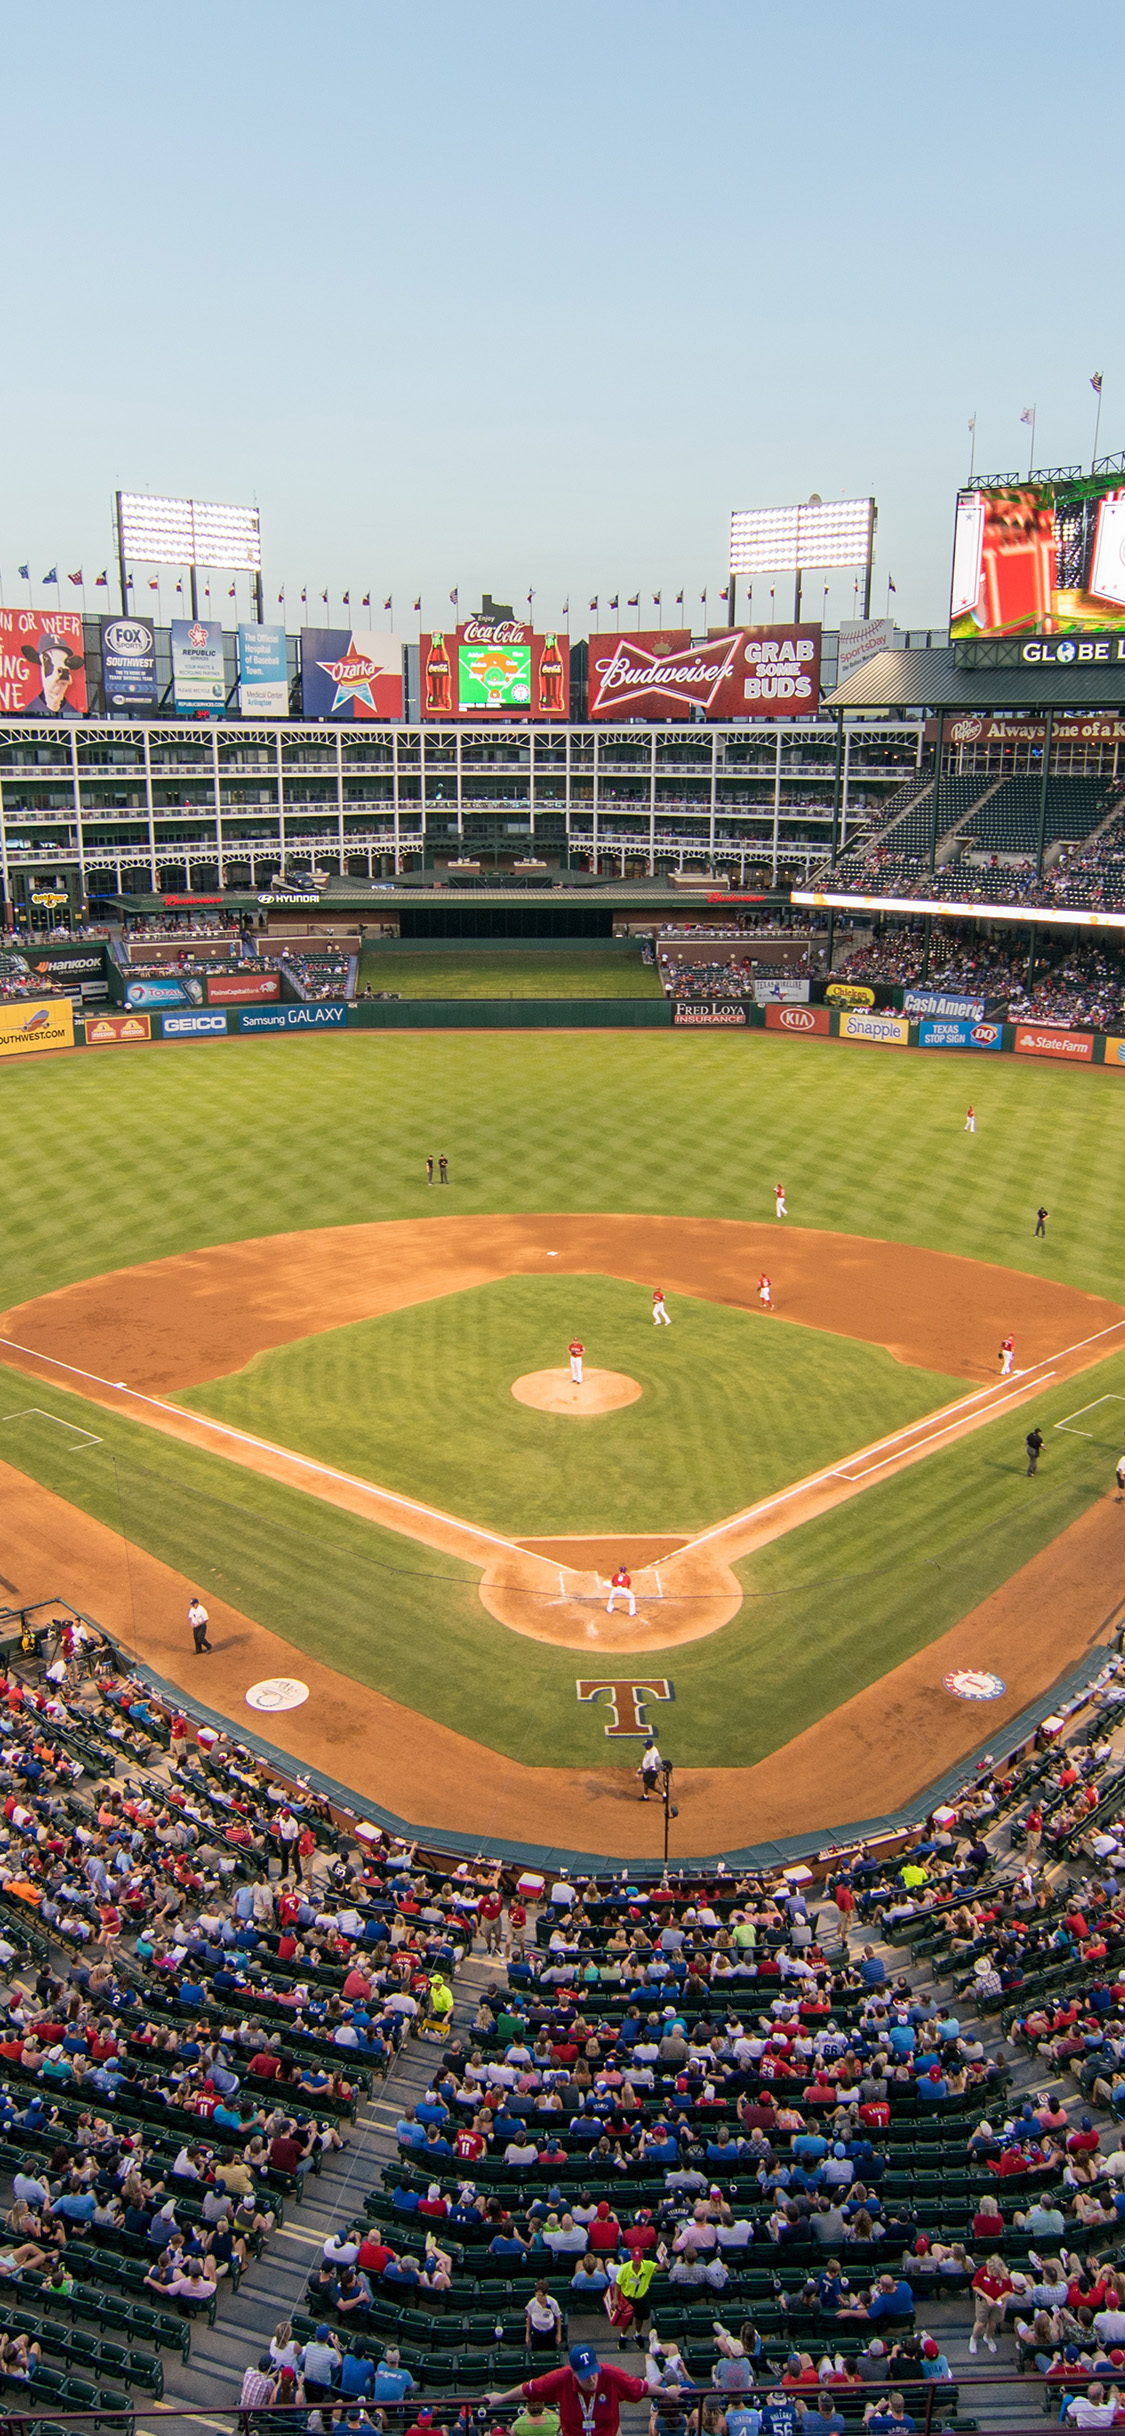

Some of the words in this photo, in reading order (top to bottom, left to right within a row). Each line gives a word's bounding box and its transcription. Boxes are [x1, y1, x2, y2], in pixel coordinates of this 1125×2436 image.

[19, 612, 38, 633] OR
[41, 615, 80, 637] WEER
[477, 615, 495, 623] Enjoy
[116, 629, 141, 643] FOX
[463, 620, 526, 643] Coca-Cola
[244, 633, 256, 643] The
[257, 633, 279, 644] Official
[182, 649, 217, 657] REPUBLIC
[245, 644, 271, 655] Hospital
[744, 640, 815, 664] GRAB
[840, 634, 887, 663] SportsDay
[106, 656, 154, 669] SOUTHWEST
[245, 655, 253, 664] of
[253, 655, 280, 665] Baseball
[331, 660, 375, 682] Ozarka
[595, 657, 734, 689] Budweiser
[755, 662, 801, 678] SOME
[744, 676, 812, 700] BUDS
[246, 691, 266, 699] Medical
[247, 700, 272, 708] Arlington
[962, 719, 973, 729] Dr
[952, 724, 980, 742] Pepper
[987, 722, 1046, 740] Always
[1081, 722, 1101, 737] of
[1101, 725, 1111, 737] a
[162, 895, 223, 906] Budweiser
[275, 894, 320, 903] HYUNDAI
[148, 988, 184, 997] TOTAL
[833, 986, 868, 999] Chicken
[676, 1003, 709, 1015] FRED
[711, 1003, 745, 1015] LOYA
[242, 1015, 285, 1027] Samsung
[287, 1007, 344, 1024] GALAXY
[676, 1015, 744, 1023] INSURANCE
[786, 1012, 809, 1026] KIA
[164, 1016, 227, 1032] GEICO
[846, 1017, 901, 1040] Snapple
[932, 1024, 959, 1034] TEXAS
[0, 1029, 65, 1045] OUTHWEST.COM
[924, 1034, 946, 1044] STOP
[945, 1034, 966, 1044] SIGN
[975, 1028, 994, 1041] DQ
[576, 1679, 673, 1738] T
[112, 1994, 121, 2007] 2
[823, 2044, 838, 2054] 66
[199, 2103, 209, 2117] 11
[877, 2114, 882, 2127] 1
[461, 2141, 470, 2156] 11
[579, 2352, 590, 2366] T
